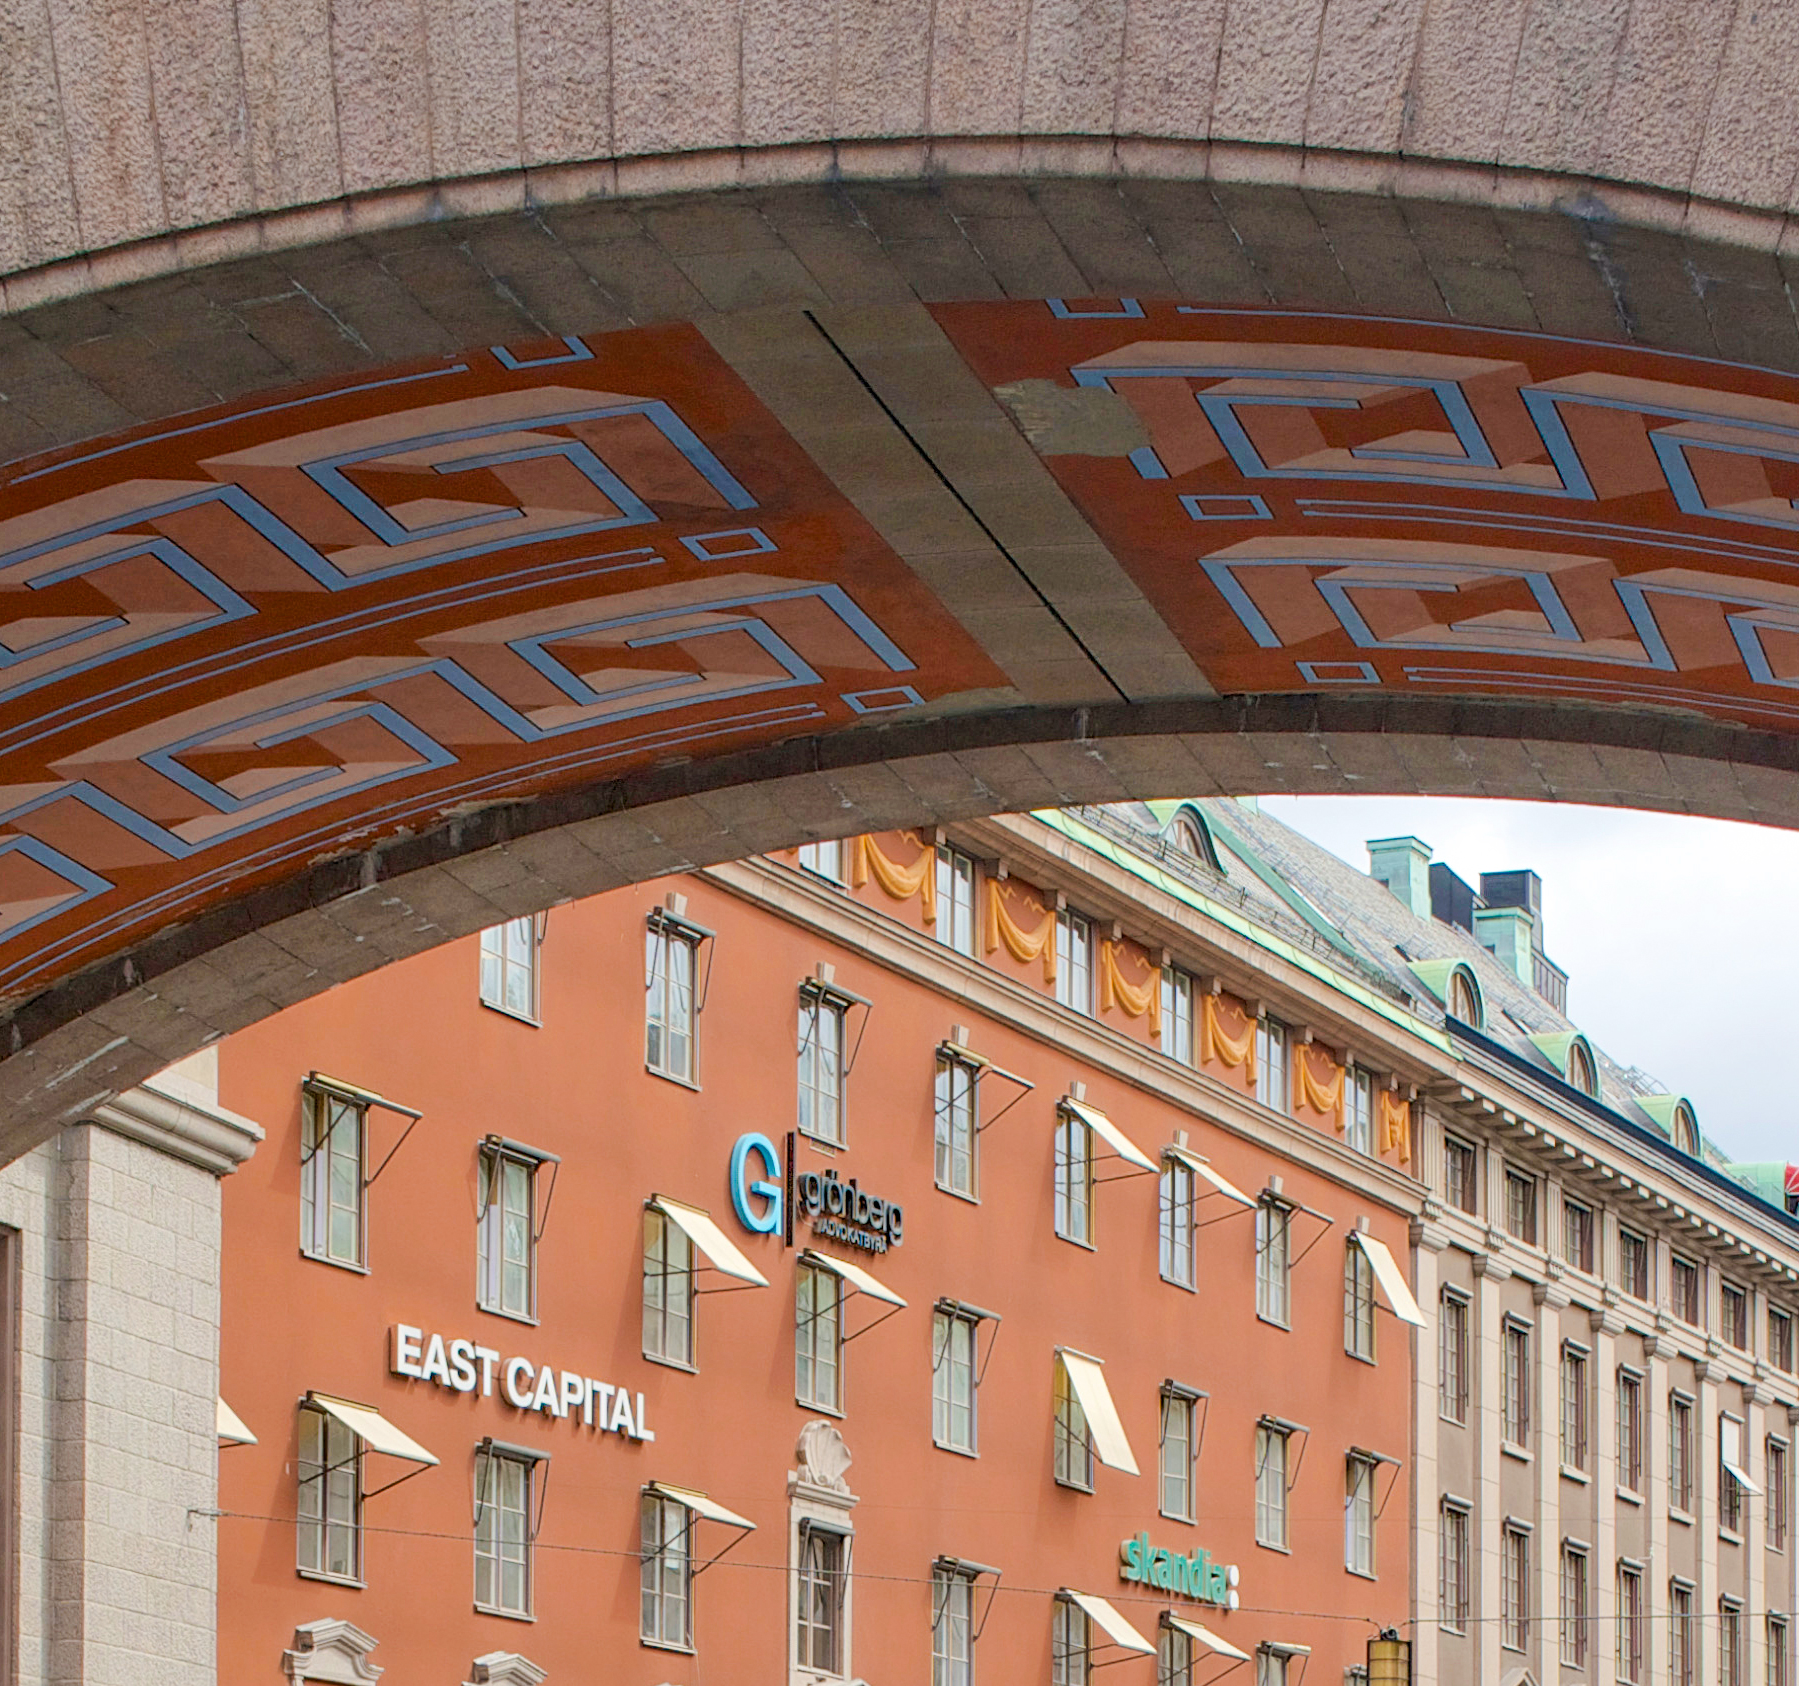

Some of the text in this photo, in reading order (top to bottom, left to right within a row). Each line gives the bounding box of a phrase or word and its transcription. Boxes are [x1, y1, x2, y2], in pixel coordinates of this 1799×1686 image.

[731, 1132, 782, 1236] G
[799, 1169, 904, 1247] grönberg
[817, 1218, 889, 1254] ADVOKATBYRÅ
[393, 1323, 656, 1442] EAST CAPITAL
